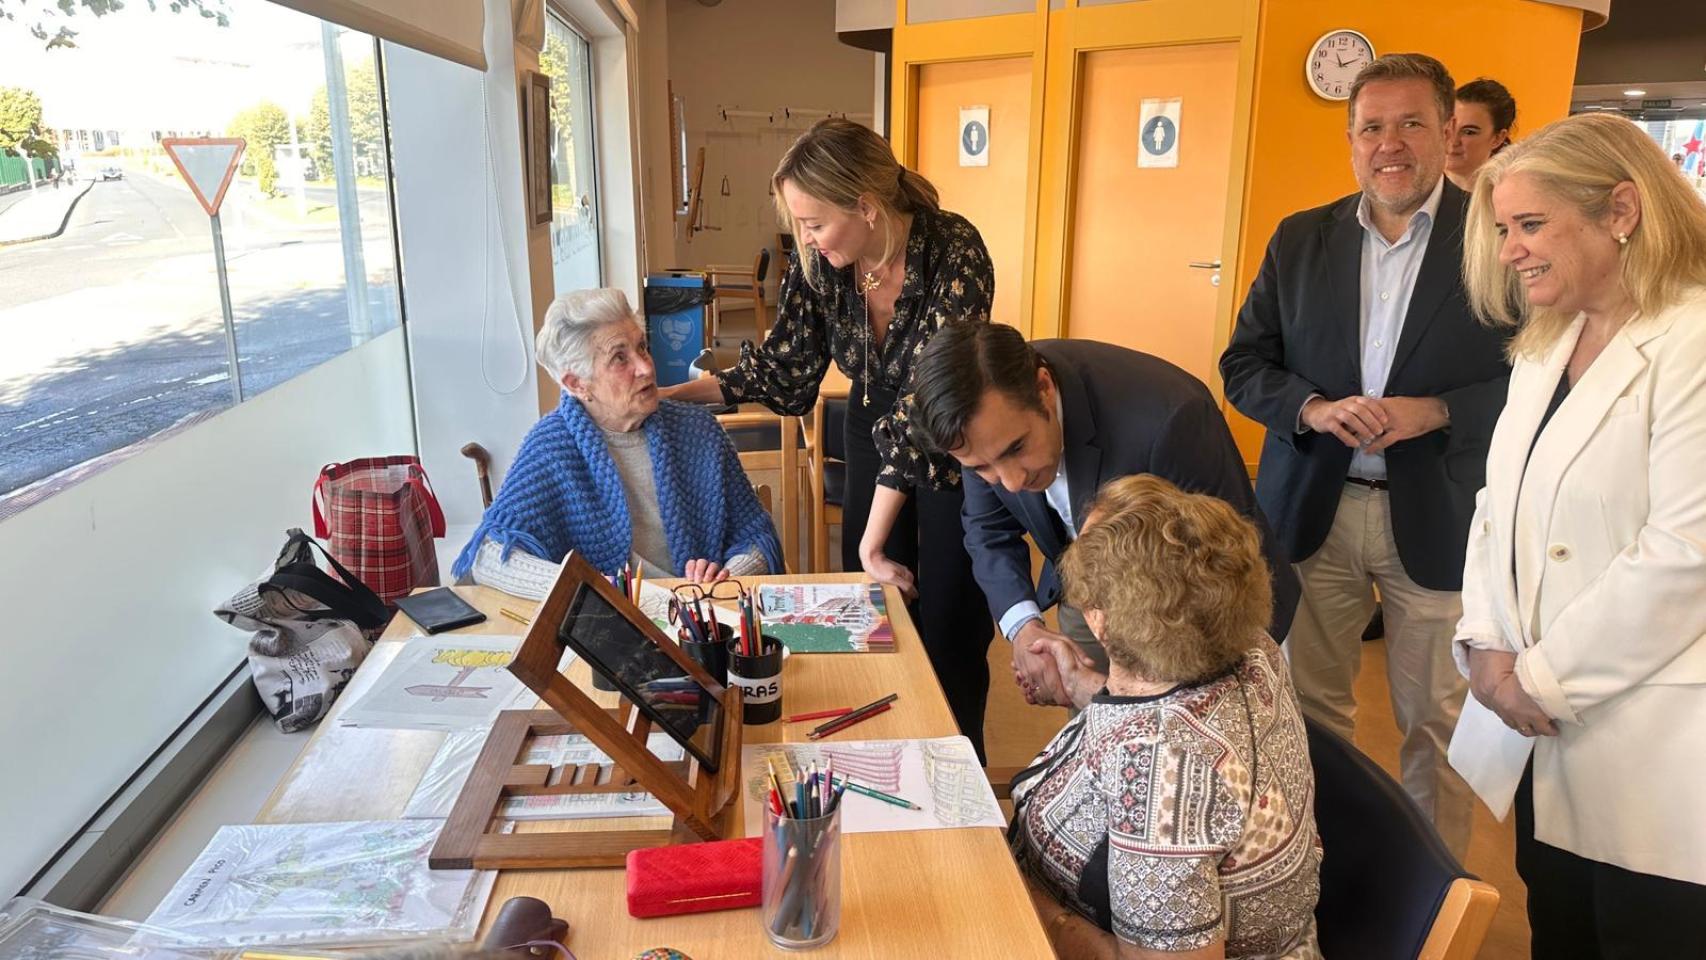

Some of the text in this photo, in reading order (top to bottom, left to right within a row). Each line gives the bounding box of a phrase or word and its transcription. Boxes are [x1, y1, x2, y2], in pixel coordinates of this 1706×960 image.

[1328, 39, 1335, 48] 11
[1338, 37, 1348, 46] 12
[1318, 49, 1327, 58] 10
[1358, 48, 1364, 56] 2
[1314, 61, 1321, 70] 9
[1324, 82, 1331, 92] 7
[1334, 85, 1342, 94] 6
